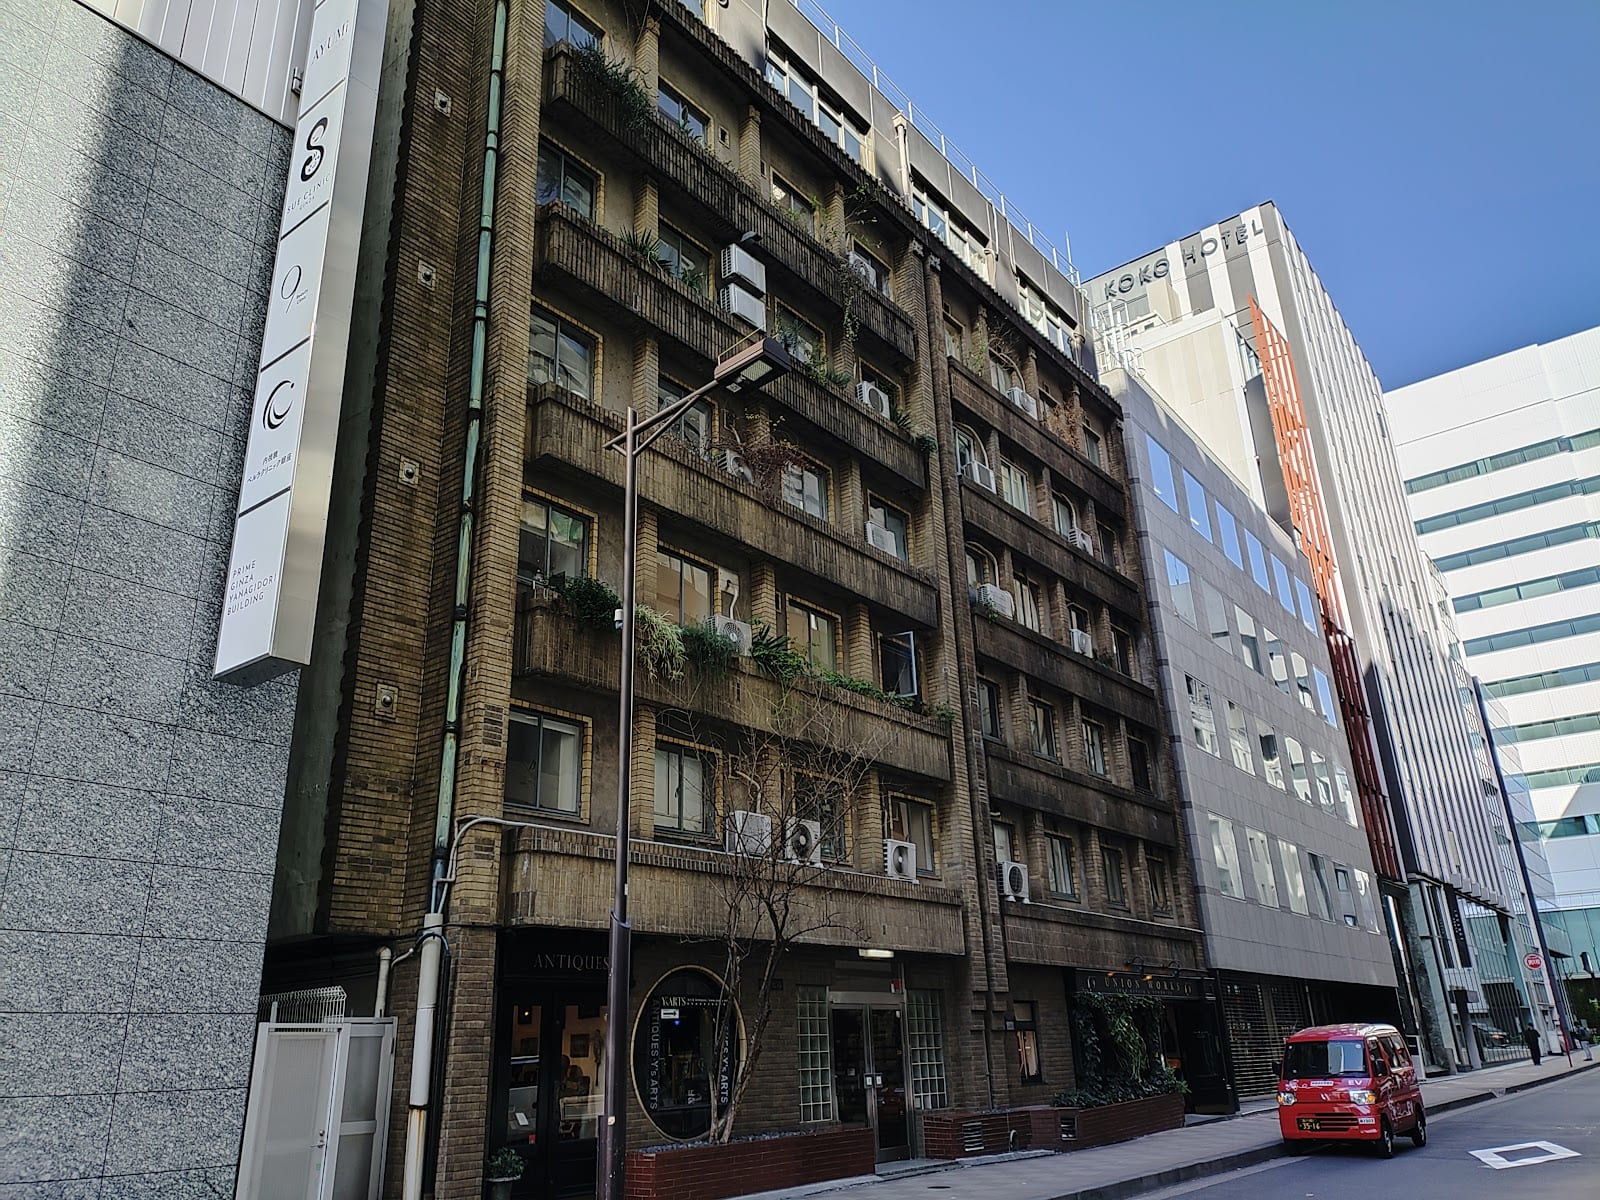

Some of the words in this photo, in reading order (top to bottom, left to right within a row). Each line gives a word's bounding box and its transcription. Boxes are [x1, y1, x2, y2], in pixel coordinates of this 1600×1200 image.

[303, 175, 330, 201] CLINIC
[1104, 258, 1170, 300] KOKO
[1183, 219, 1264, 268] HOTEL
[232, 560, 256, 578] PRIME
[229, 572, 277, 603] YANAGIDORI
[230, 574, 254, 591] GINZA
[227, 591, 264, 616] BUILDING
[533, 953, 610, 972] ANTIQUES
[649, 1079, 659, 1110] ARTS
[720, 1074, 729, 1104] ARTS
